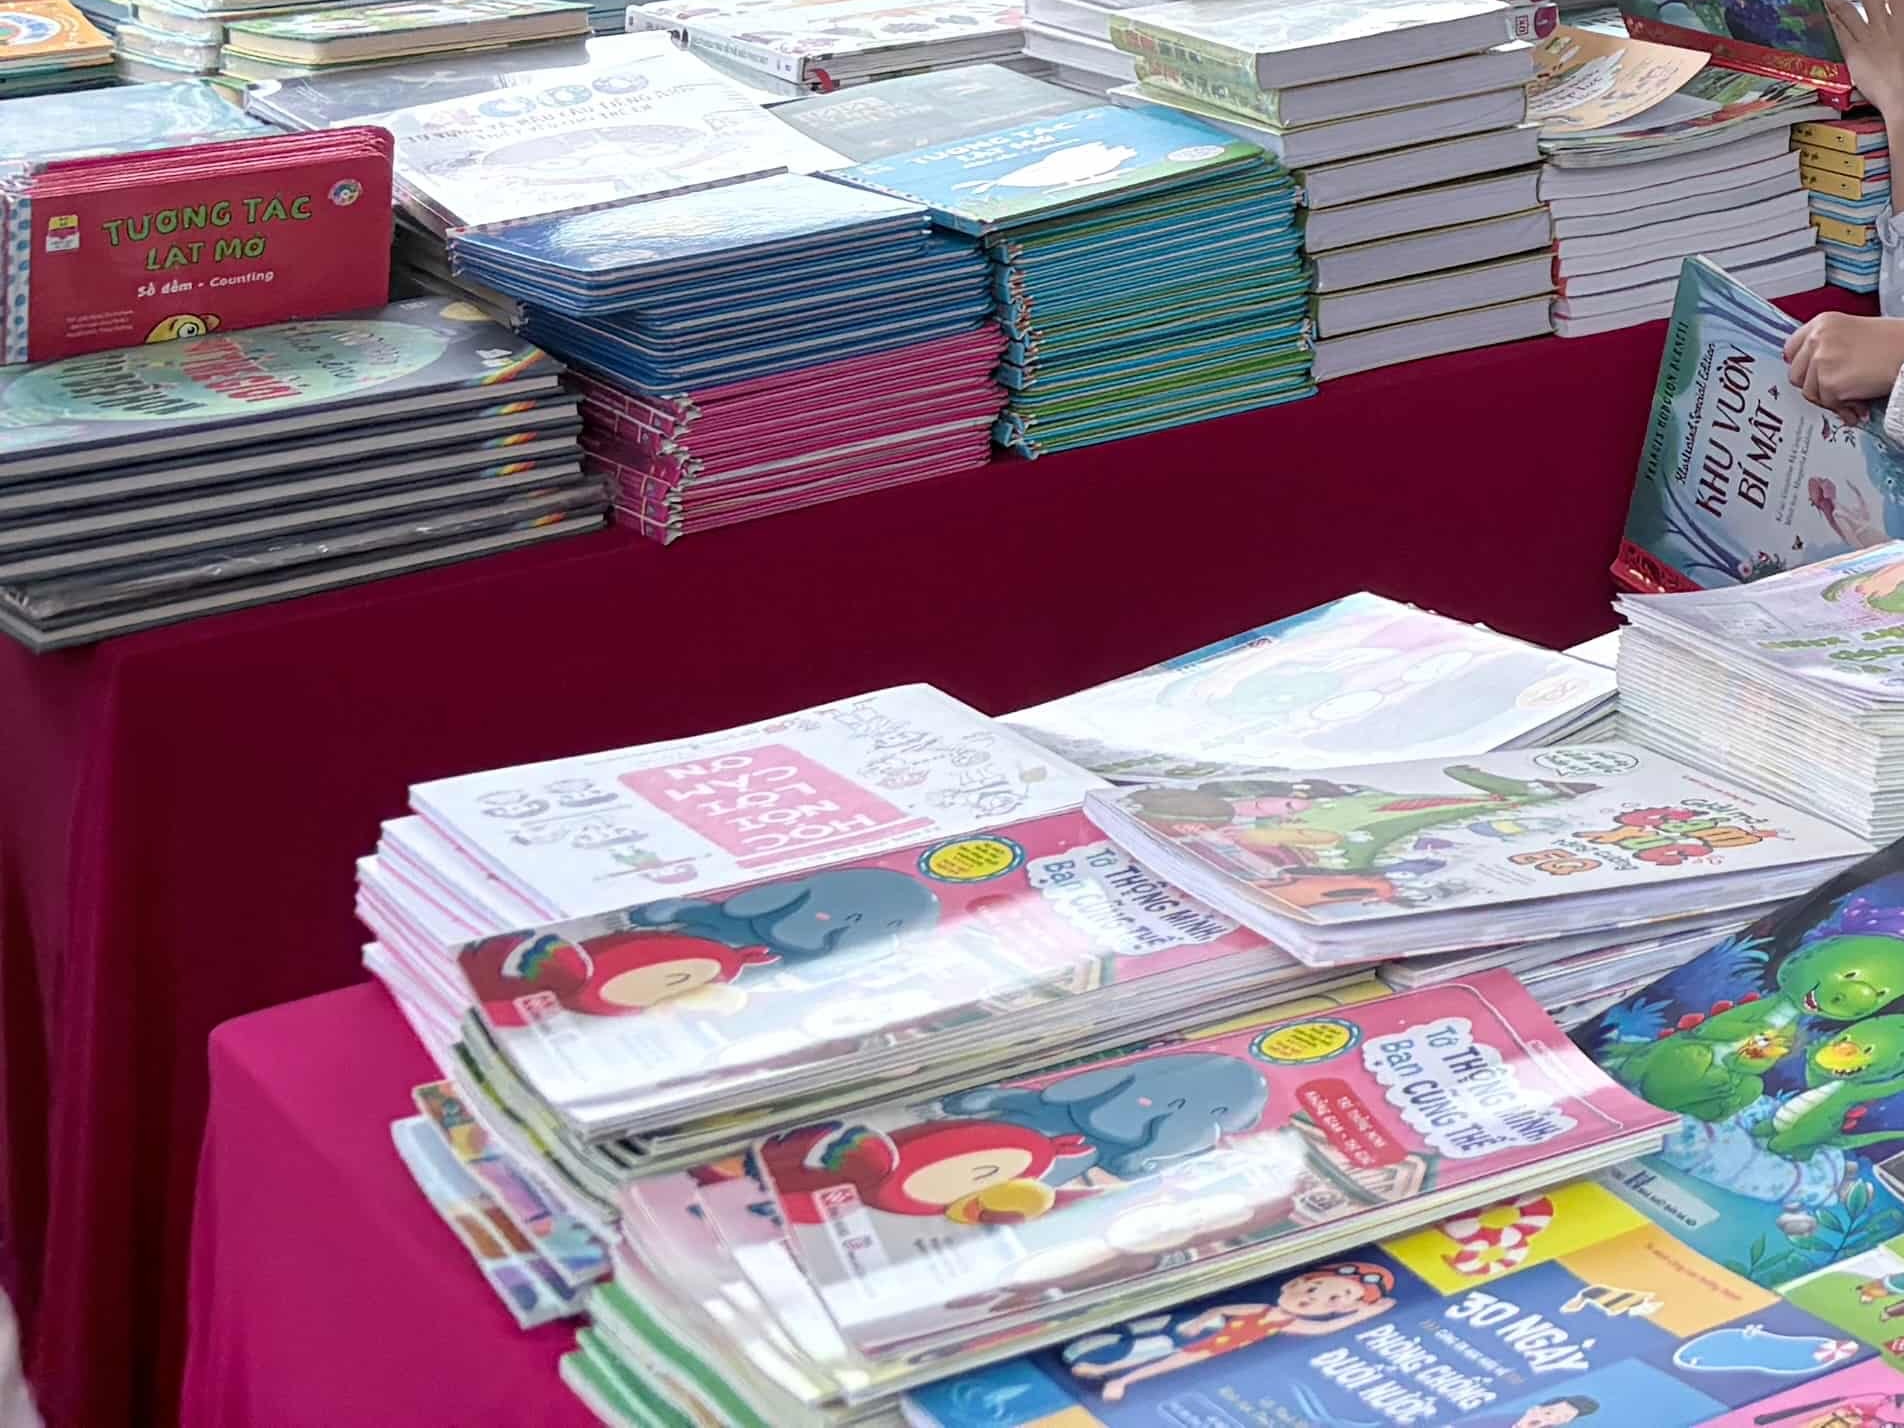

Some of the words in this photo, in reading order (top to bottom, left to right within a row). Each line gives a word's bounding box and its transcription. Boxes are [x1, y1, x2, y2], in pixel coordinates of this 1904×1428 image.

[102, 201, 232, 247] TƯƠNG
[244, 193, 313, 224] TÁC
[210, 270, 275, 288] Counting
[1713, 344, 1756, 433] VƯỜN
[1748, 399, 1784, 471] MẬT
[1695, 438, 1733, 518] KHU
[1738, 464, 1769, 509] BÍ
[1038, 858, 1082, 891] Bạn
[1085, 846, 1113, 869] Tớ
[1426, 1024, 1461, 1049] Tớ
[1372, 1038, 1424, 1079] Bạn
[1403, 1079, 1464, 1133] CŨNG
[1354, 1322, 1439, 1374] PHÒNG
[1414, 1356, 1499, 1413] CHỐNG
[1444, 1291, 1515, 1329] 30
[1496, 1312, 1600, 1375] NGÀY
[1309, 1347, 1390, 1402] ĐUỐI
[1361, 1378, 1440, 1424] NƯỚC
